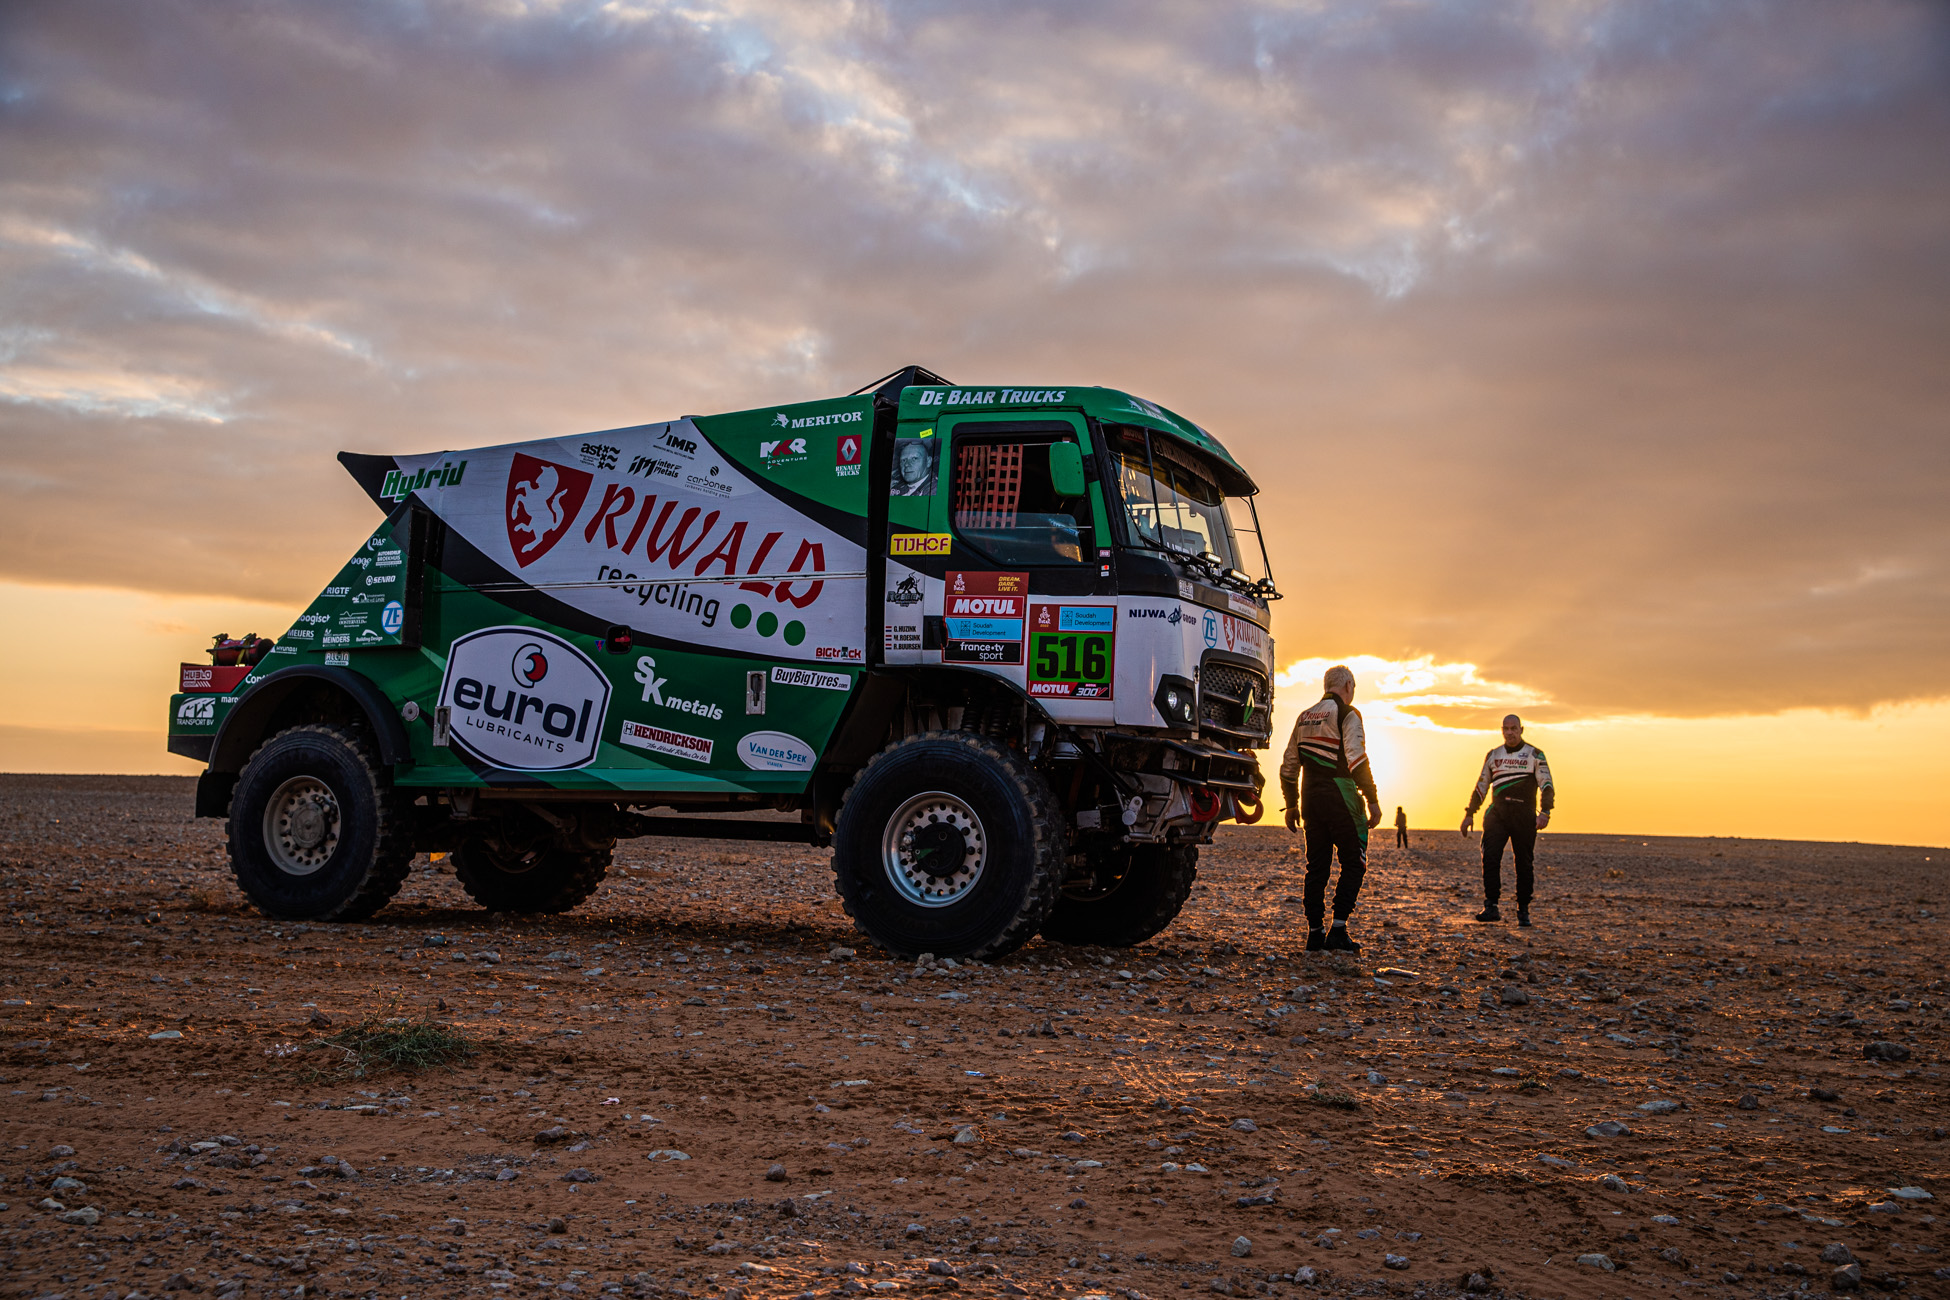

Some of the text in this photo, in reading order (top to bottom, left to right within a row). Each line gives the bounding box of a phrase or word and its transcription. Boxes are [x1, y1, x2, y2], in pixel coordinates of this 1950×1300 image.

[919, 388, 1066, 406] DE BAAR TRUCKS
[791, 411, 863, 429] MERITOR
[666, 435, 697, 455] IMR
[657, 458, 676, 470] inter
[835, 464, 861, 472] RENAULT
[380, 460, 468, 503] Hybrid
[687, 474, 732, 493] carbones
[584, 483, 826, 609] RIWALD
[893, 537, 949, 552] TIJHOF
[373, 575, 396, 584] SENRO
[597, 565, 720, 628] recycling
[953, 598, 1016, 615] MOTUL
[1074, 619, 1111, 627] Development
[1129, 608, 1197, 626] NIJWA GROEP
[972, 630, 1007, 638] Development
[979, 652, 1004, 662] sport
[1036, 635, 1106, 680] 516
[1031, 683, 1070, 695] MOTUL
[1076, 687, 1109, 697] 300V
[453, 677, 594, 744] eurol
[665, 696, 724, 720] metals
[177, 718, 206, 726] TRANSPORT
[466, 716, 565, 753] LUBRICANTS
[633, 724, 713, 754] HENDRICKSON
[749, 742, 807, 763] VAN DER SPEK
